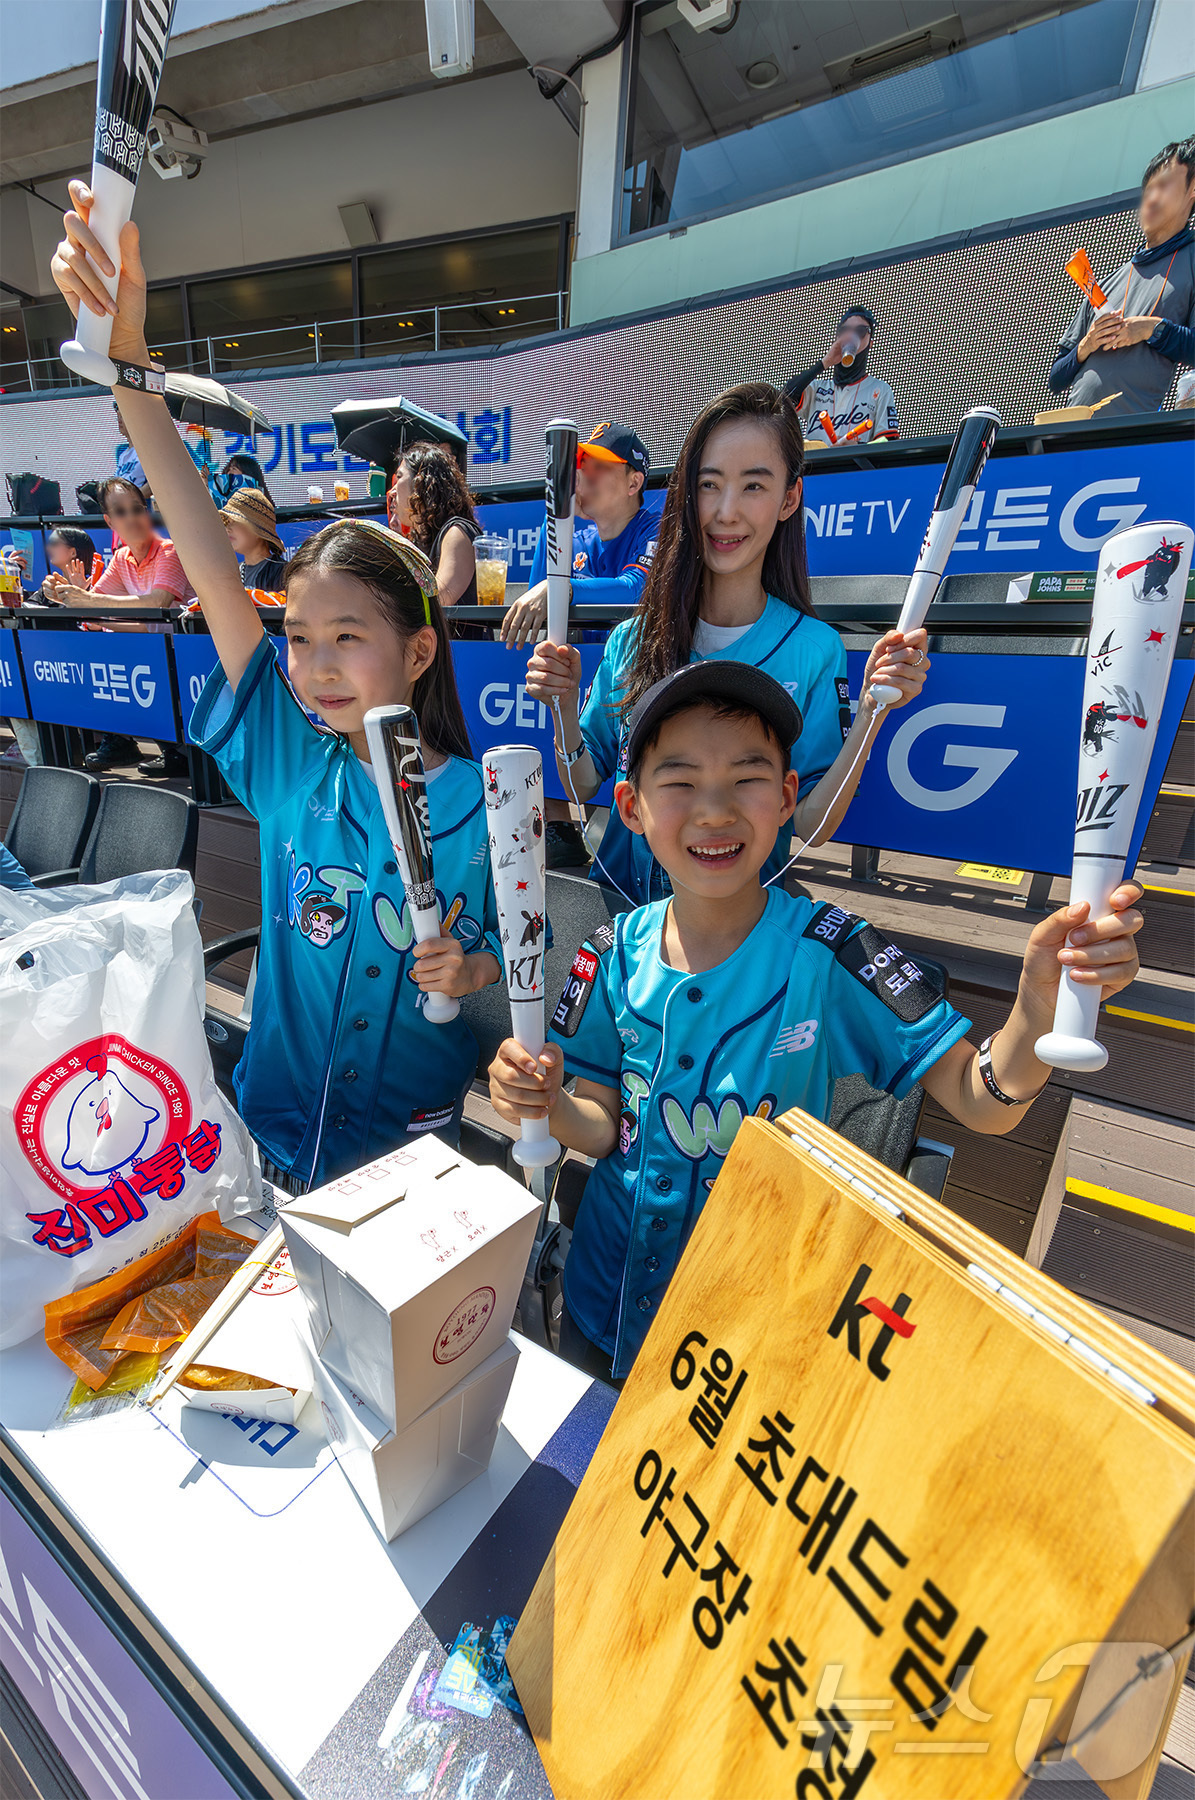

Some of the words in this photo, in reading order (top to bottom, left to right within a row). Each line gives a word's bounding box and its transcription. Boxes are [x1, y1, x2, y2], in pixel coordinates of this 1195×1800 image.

[862, 499, 911, 535] TV
[1039, 576, 1062, 586] PAPA
[34, 660, 69, 684] GENIE
[69, 663, 84, 685] TV
[90, 662, 156, 708] 모든G
[1091, 656, 1113, 677] vic
[21, 1104, 39, 1134] 진실로
[31, 1066, 69, 1101] 아름다운
[68, 1056, 82, 1069] 맛
[121, 1047, 157, 1074] CHICKEN
[155, 1070, 179, 1095] SINCE
[171, 1098, 183, 1119] 1981
[26, 1119, 223, 1259] 진미통닭
[457, 1304, 477, 1325] 1977
[827, 1263, 917, 1382] kt
[633, 1448, 753, 1651] 야구장
[669, 1330, 749, 1450] 6월
[734, 1410, 989, 1732] 초대드림
